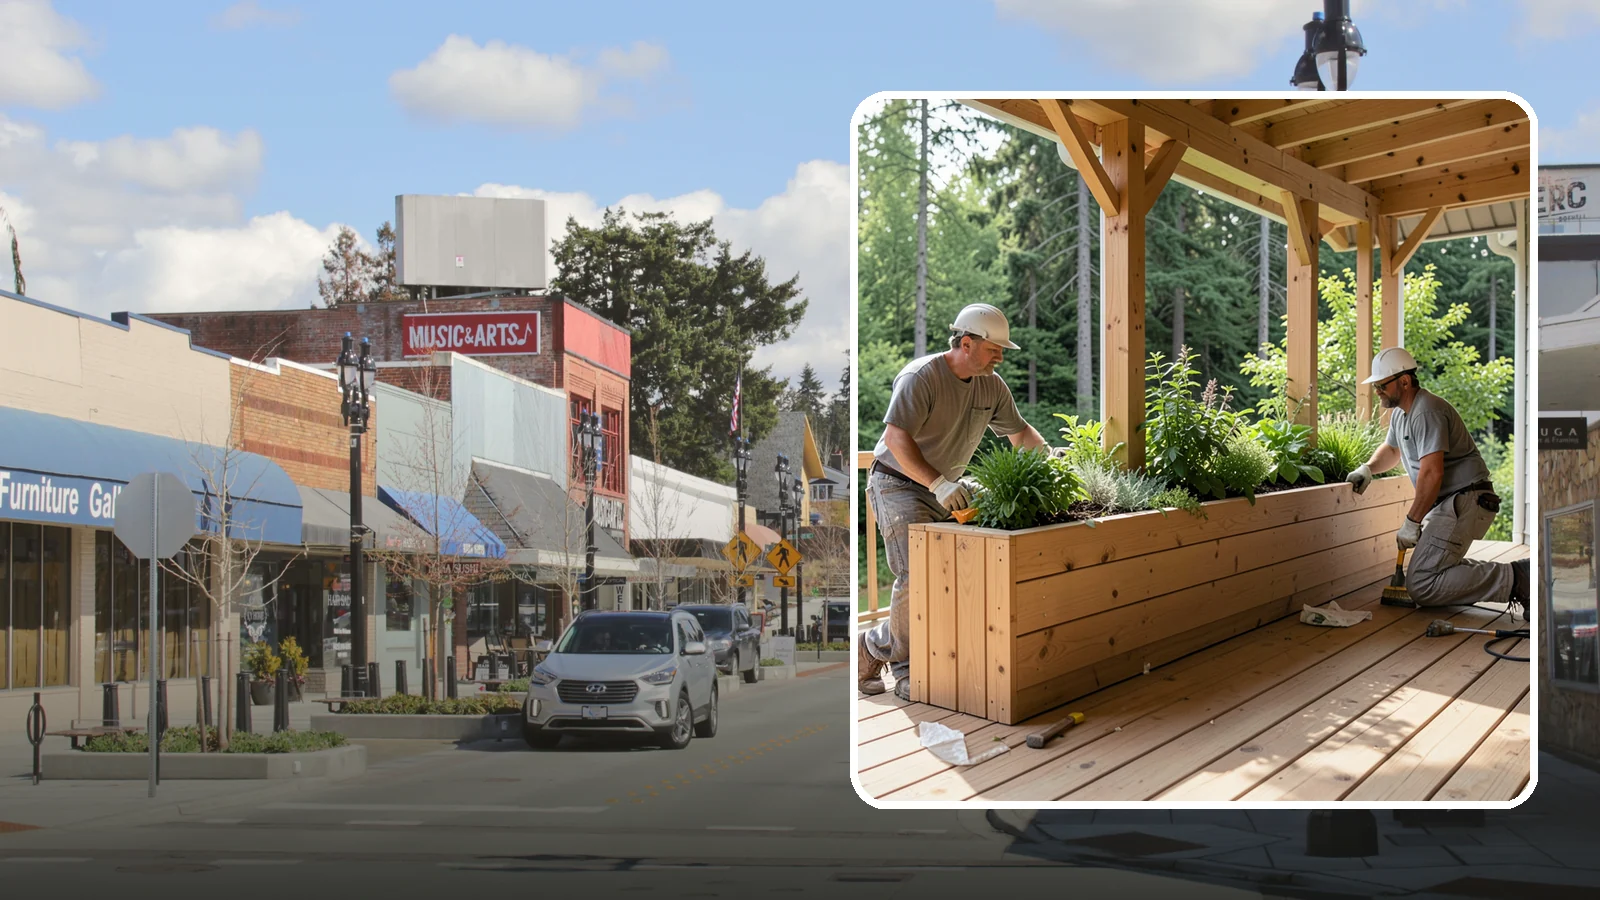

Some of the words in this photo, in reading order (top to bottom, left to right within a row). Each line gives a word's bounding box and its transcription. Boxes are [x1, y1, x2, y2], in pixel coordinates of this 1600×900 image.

[409, 323, 519, 348] MUSIC&ARTS
[1540, 427, 1577, 436] UGA
[0, 472, 79, 515] Furniture
[89, 483, 121, 519] Gal
